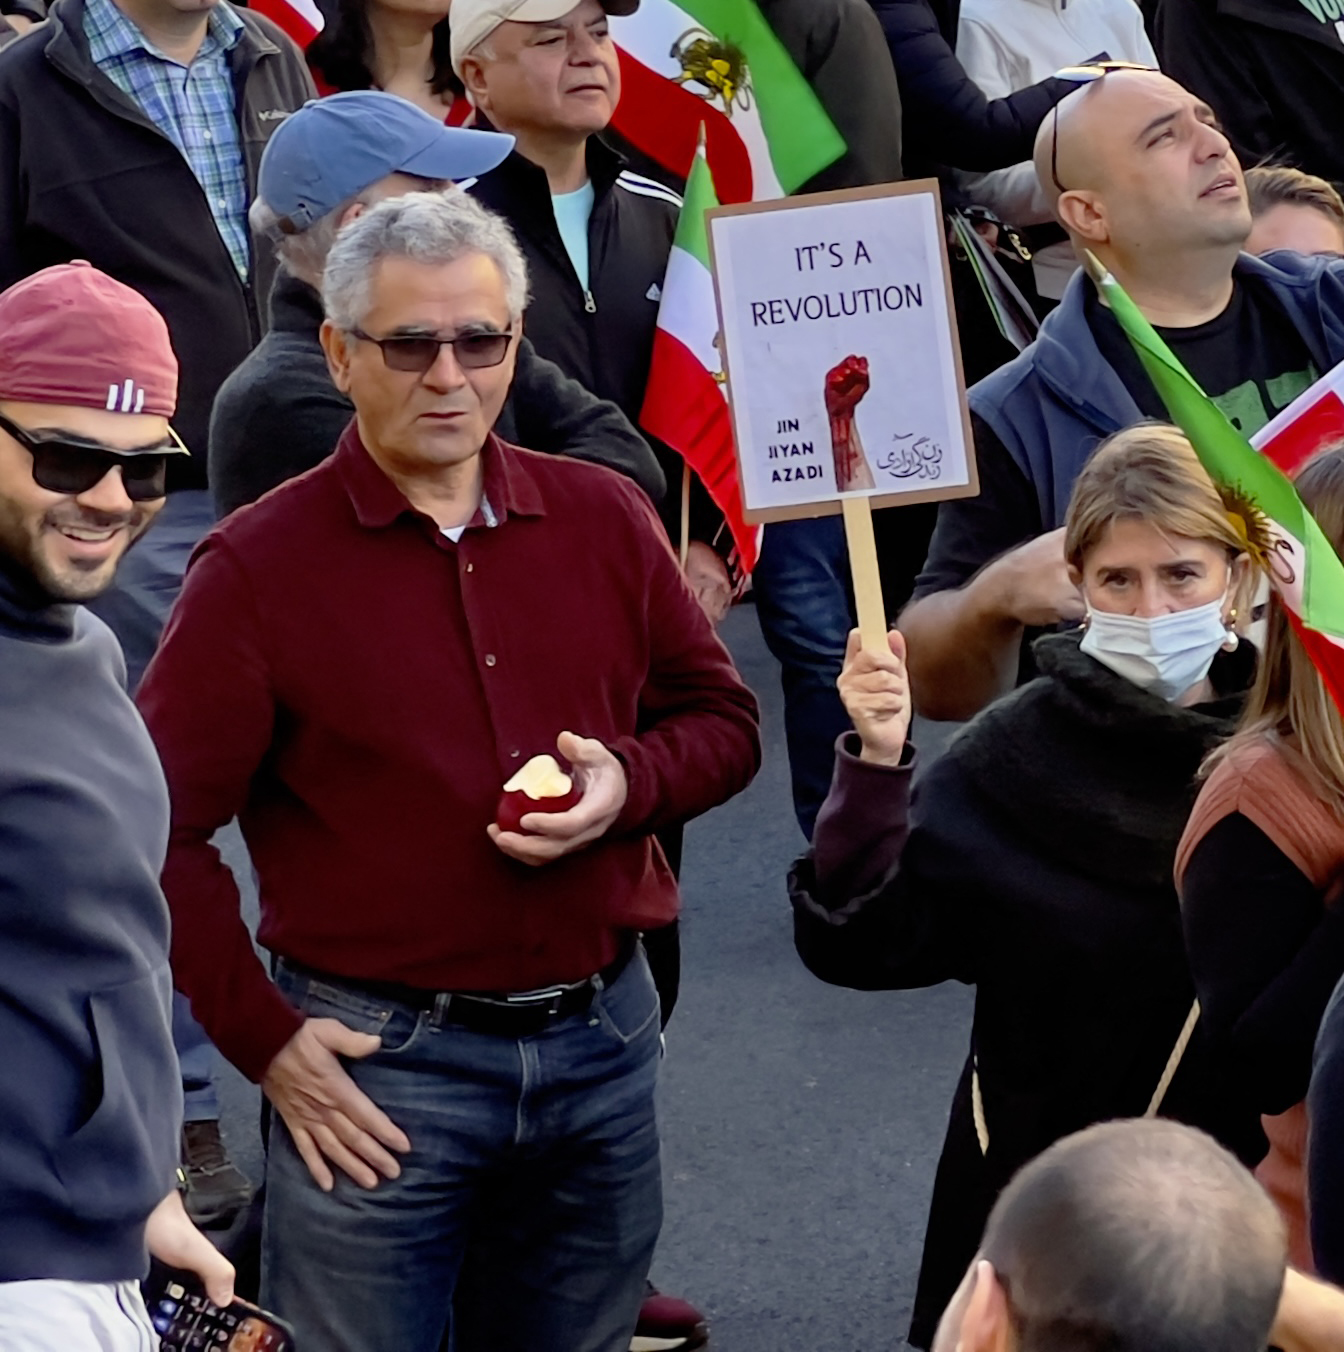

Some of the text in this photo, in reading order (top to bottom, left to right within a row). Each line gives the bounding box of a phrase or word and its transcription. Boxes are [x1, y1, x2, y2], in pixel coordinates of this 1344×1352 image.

[795, 240, 872, 272] IT'S A
[751, 282, 924, 327] REVOLUTION
[777, 418, 799, 434] JIN
[768, 441, 815, 459] JIYAN
[771, 464, 824, 484] AZADI
